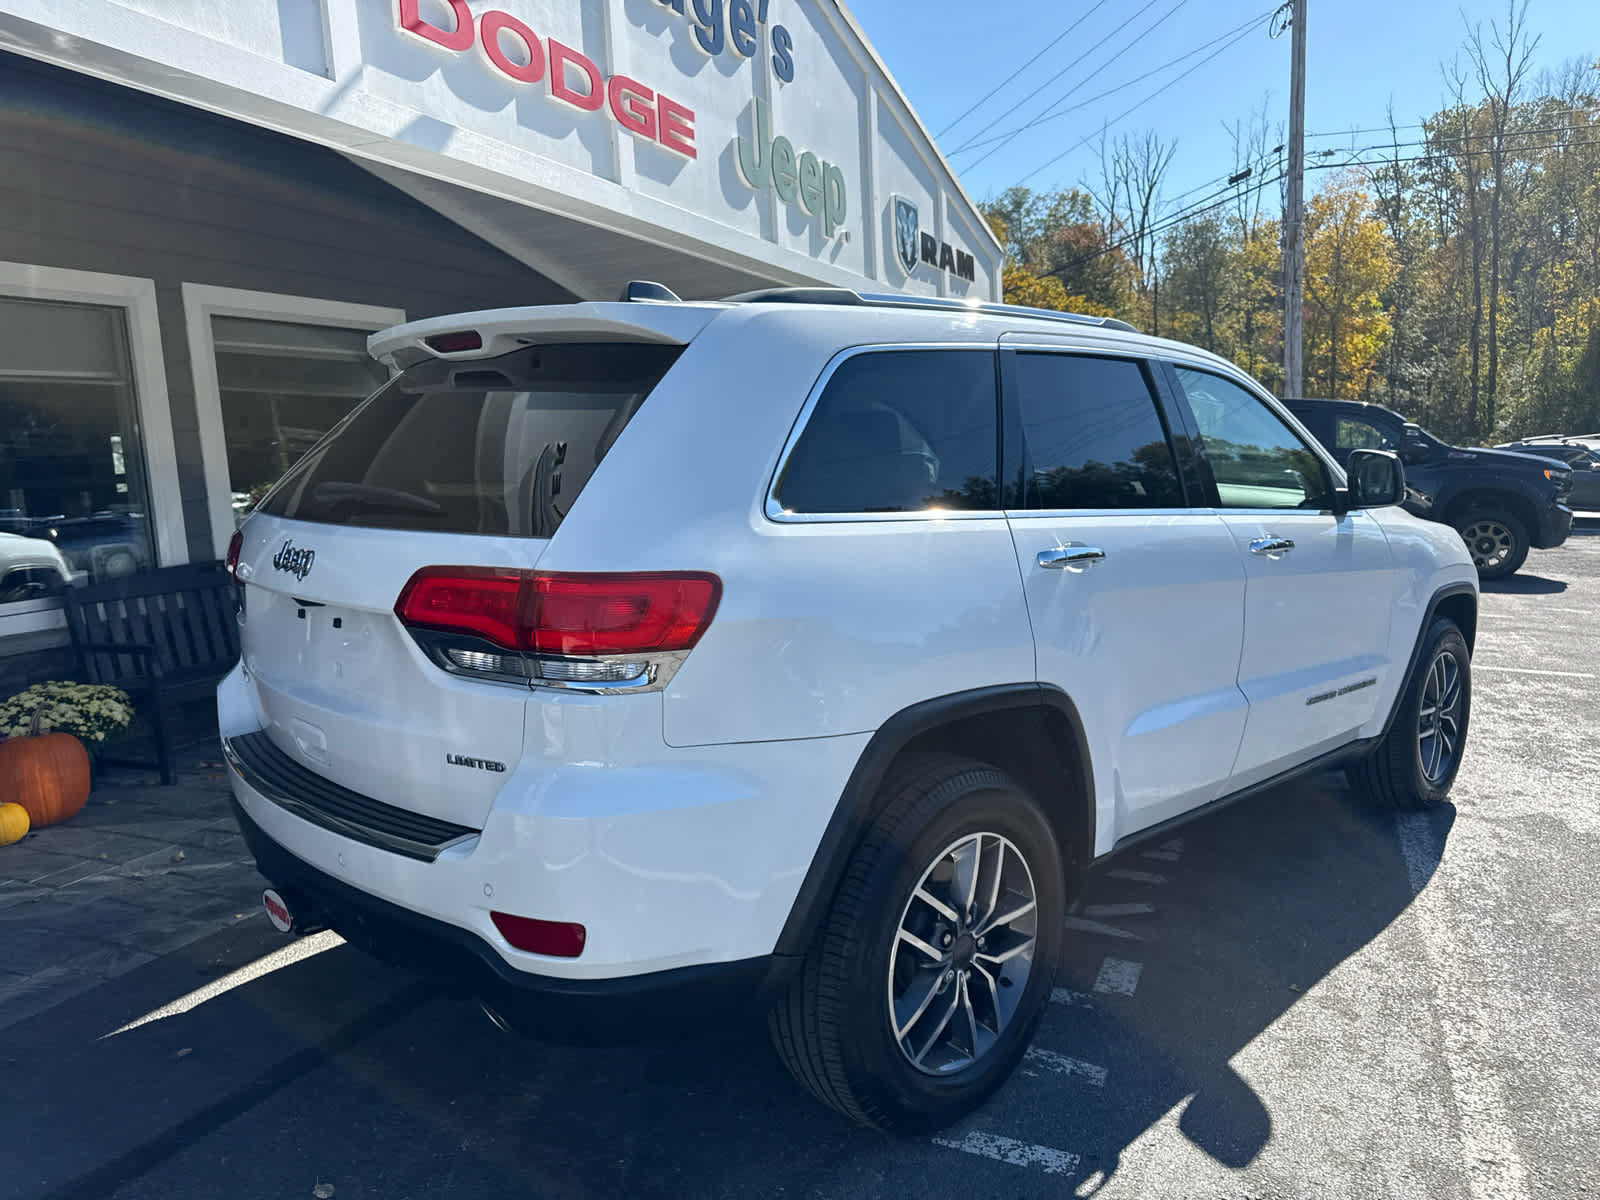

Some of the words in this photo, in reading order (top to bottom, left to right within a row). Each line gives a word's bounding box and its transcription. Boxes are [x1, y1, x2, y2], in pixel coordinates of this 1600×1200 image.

[394, 0, 697, 159] DODGE
[735, 97, 847, 239] Jeep
[920, 231, 975, 282] RAM
[273, 539, 315, 582] Jeep
[446, 753, 506, 773] LIMITED
